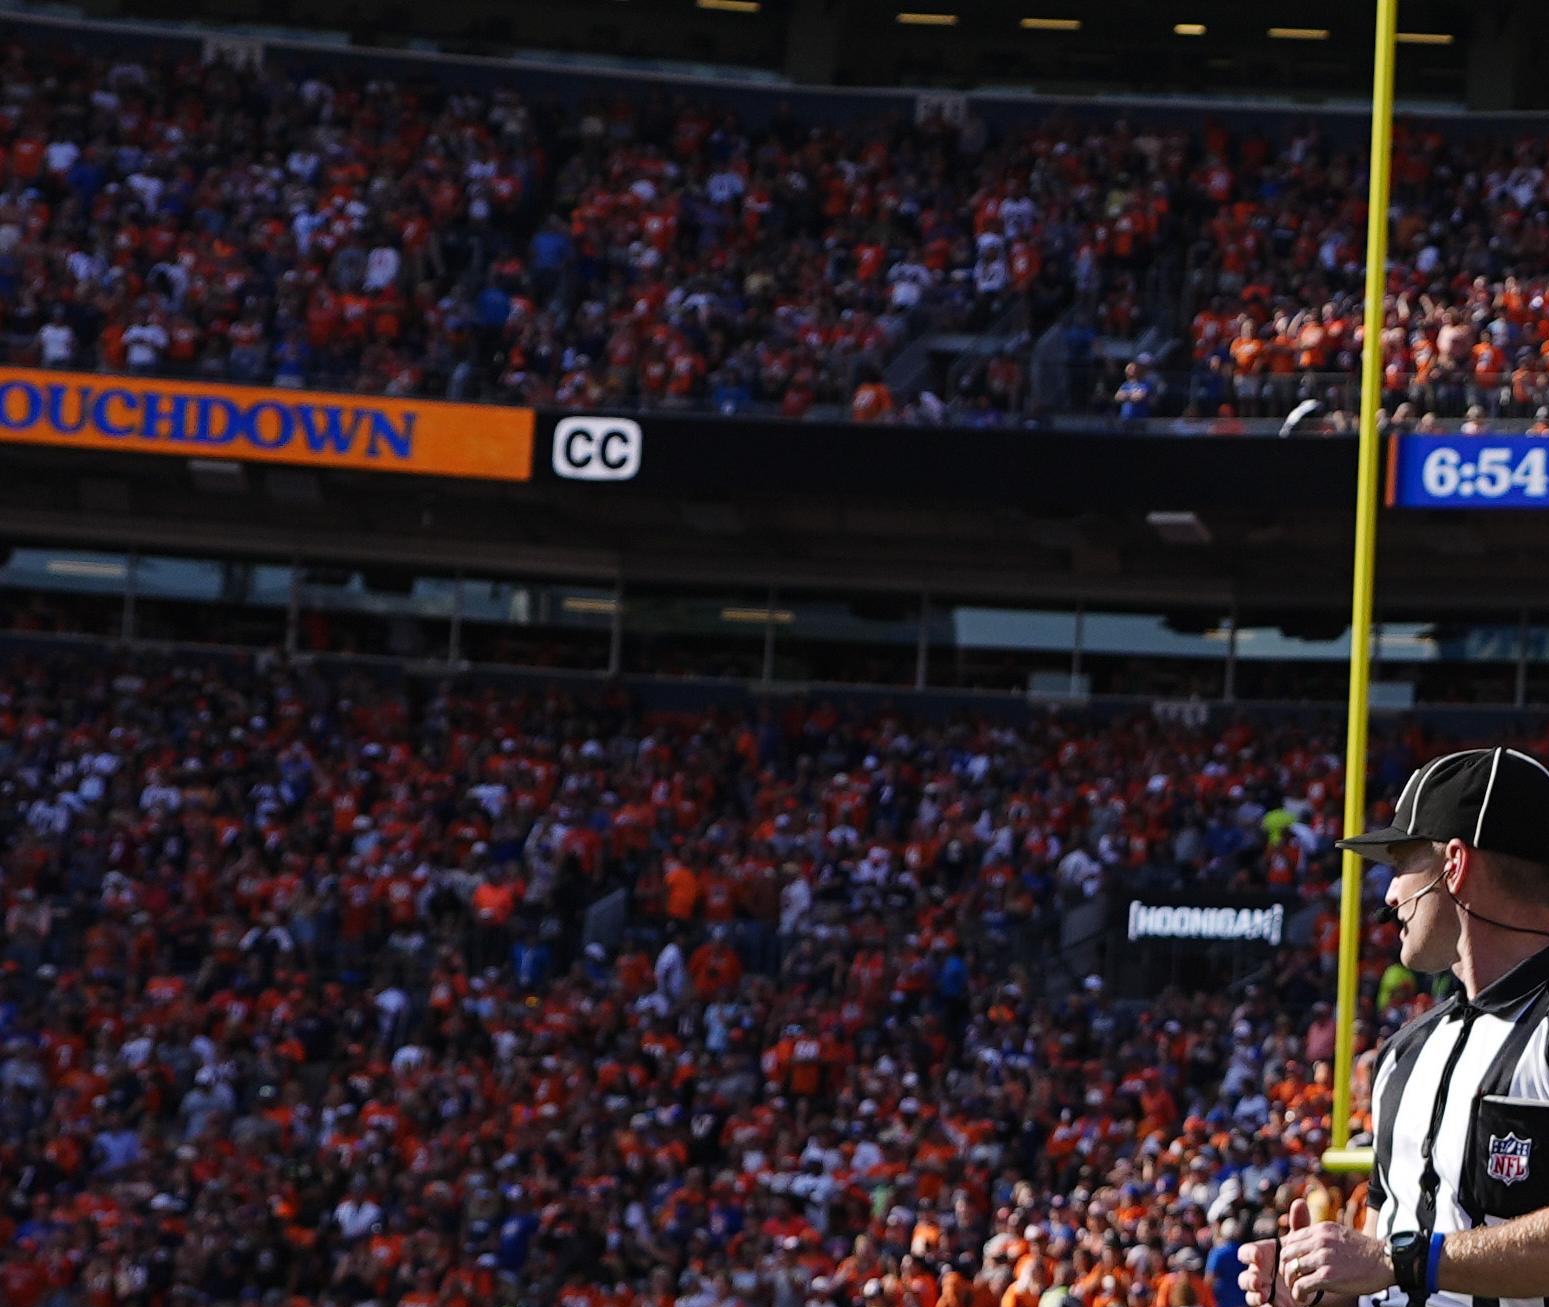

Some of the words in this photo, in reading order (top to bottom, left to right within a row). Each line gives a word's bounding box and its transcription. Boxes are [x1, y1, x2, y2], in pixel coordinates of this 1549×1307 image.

[564, 429, 629, 470] CC
[1421, 446, 1549, 498] 6:54
[1493, 1152, 1525, 1178] NFL
